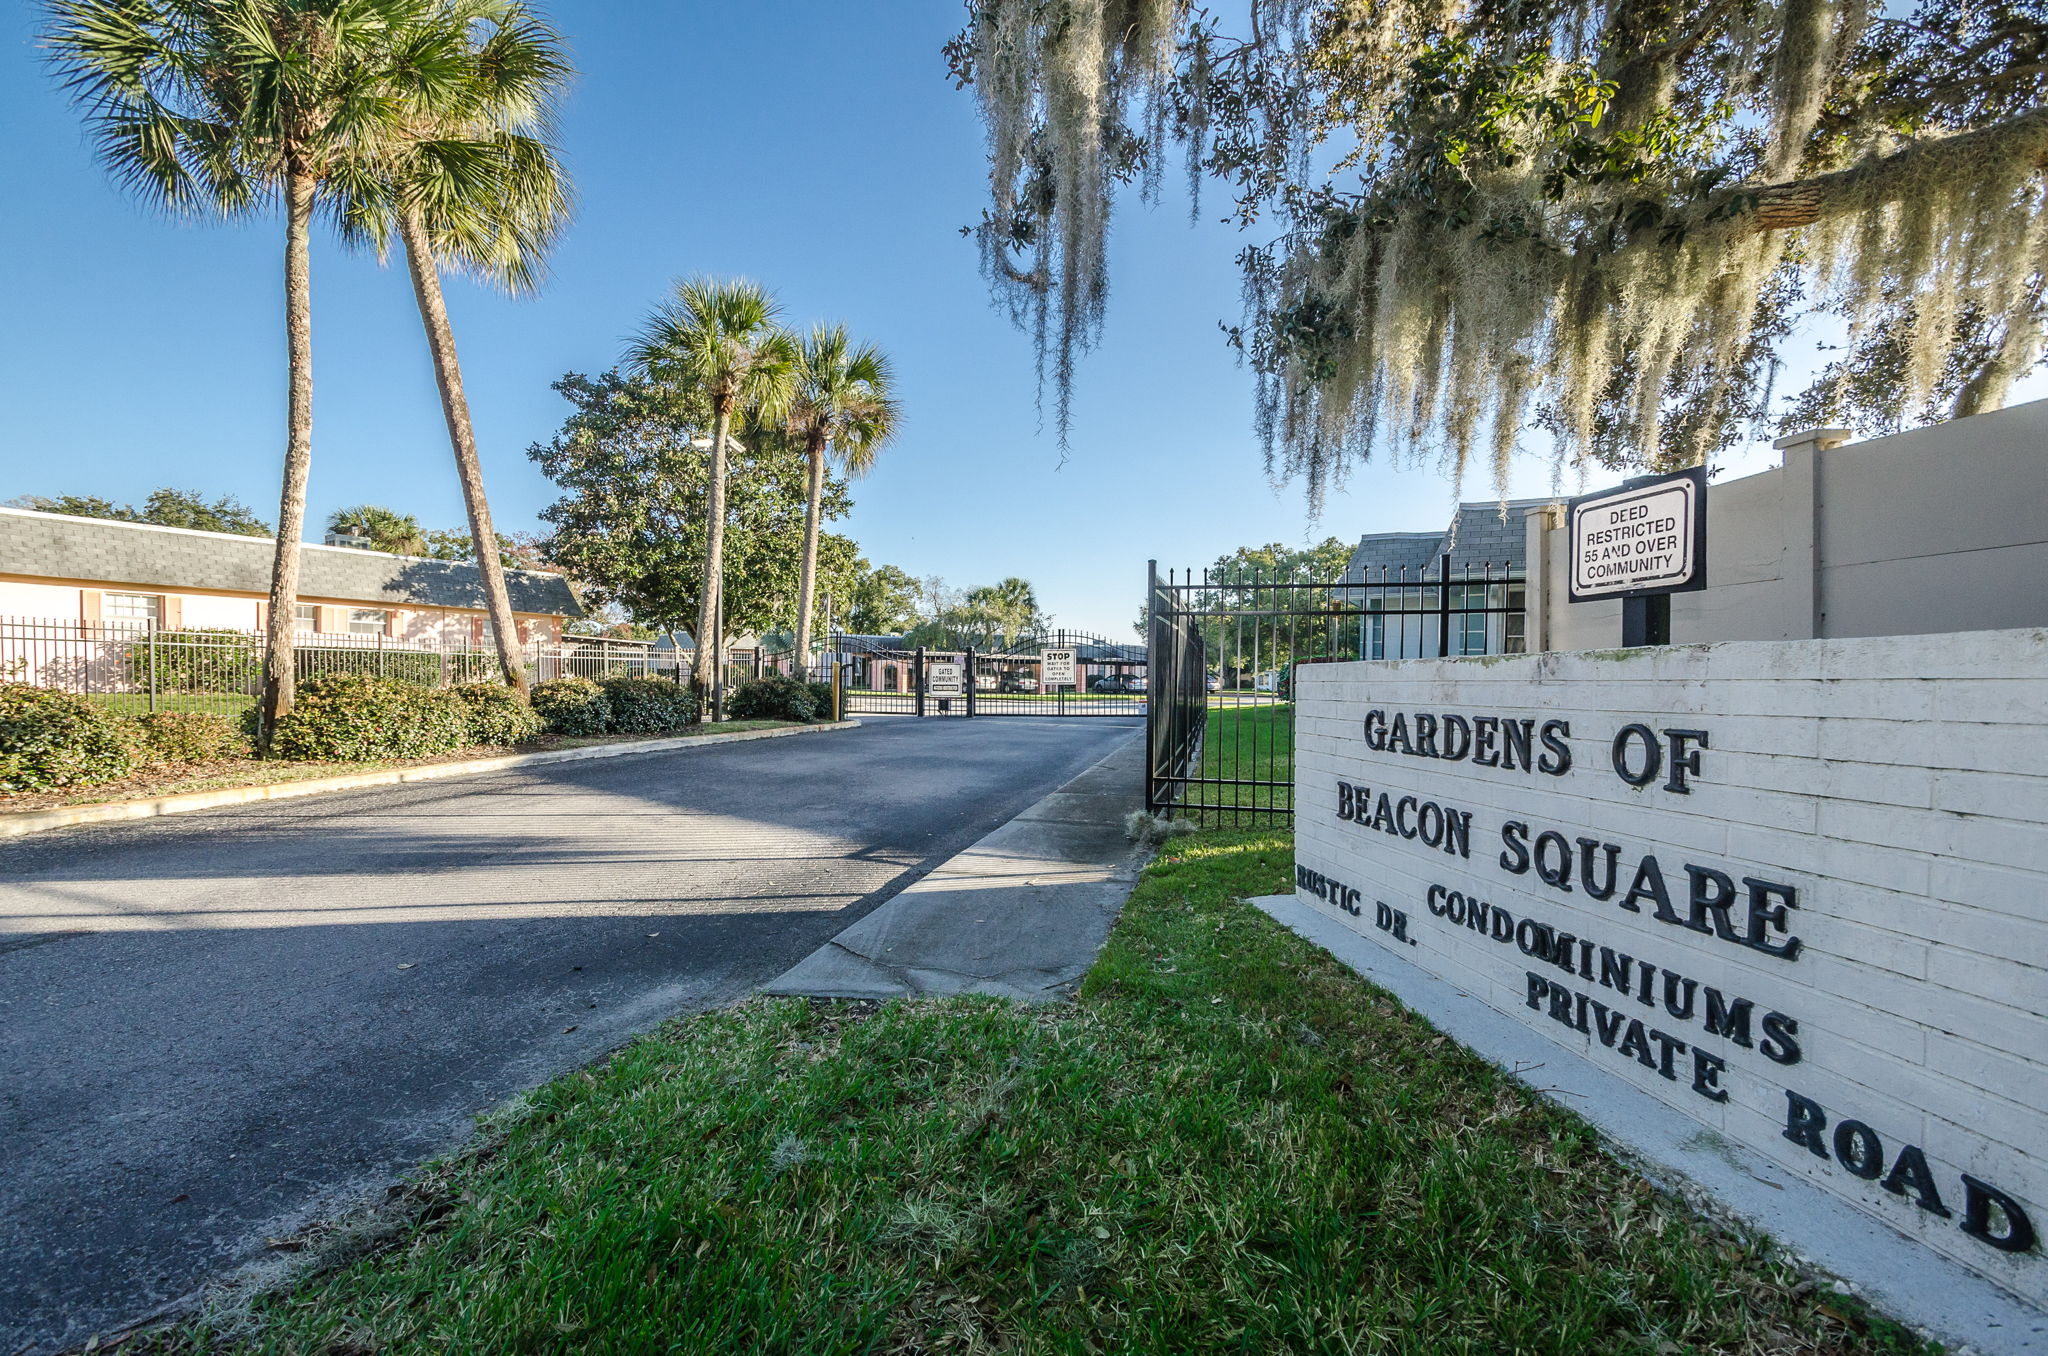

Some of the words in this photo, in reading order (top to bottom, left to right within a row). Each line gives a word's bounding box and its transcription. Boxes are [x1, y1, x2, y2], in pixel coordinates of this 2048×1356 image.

[1587, 517, 1675, 546] RESTRICTED
[1610, 505, 1648, 524] DEED
[1584, 549, 1598, 563] 55
[1602, 544, 1630, 560] AND
[1636, 535, 1677, 554] OVER
[1587, 554, 1673, 579] COMMUNITY
[1363, 709, 1571, 776] GARDENS
[1612, 723, 1709, 794] OF
[1336, 781, 1472, 858] BEACON
[1500, 820, 1802, 961] SQUARE
[1427, 883, 1802, 1065] CONDOMINIUMS
[1296, 864, 1361, 917] RUSTIC
[1376, 900, 1417, 947] DR.
[1525, 971, 1728, 1102] PRIVATE
[1783, 1089, 2037, 1252] ROAD
